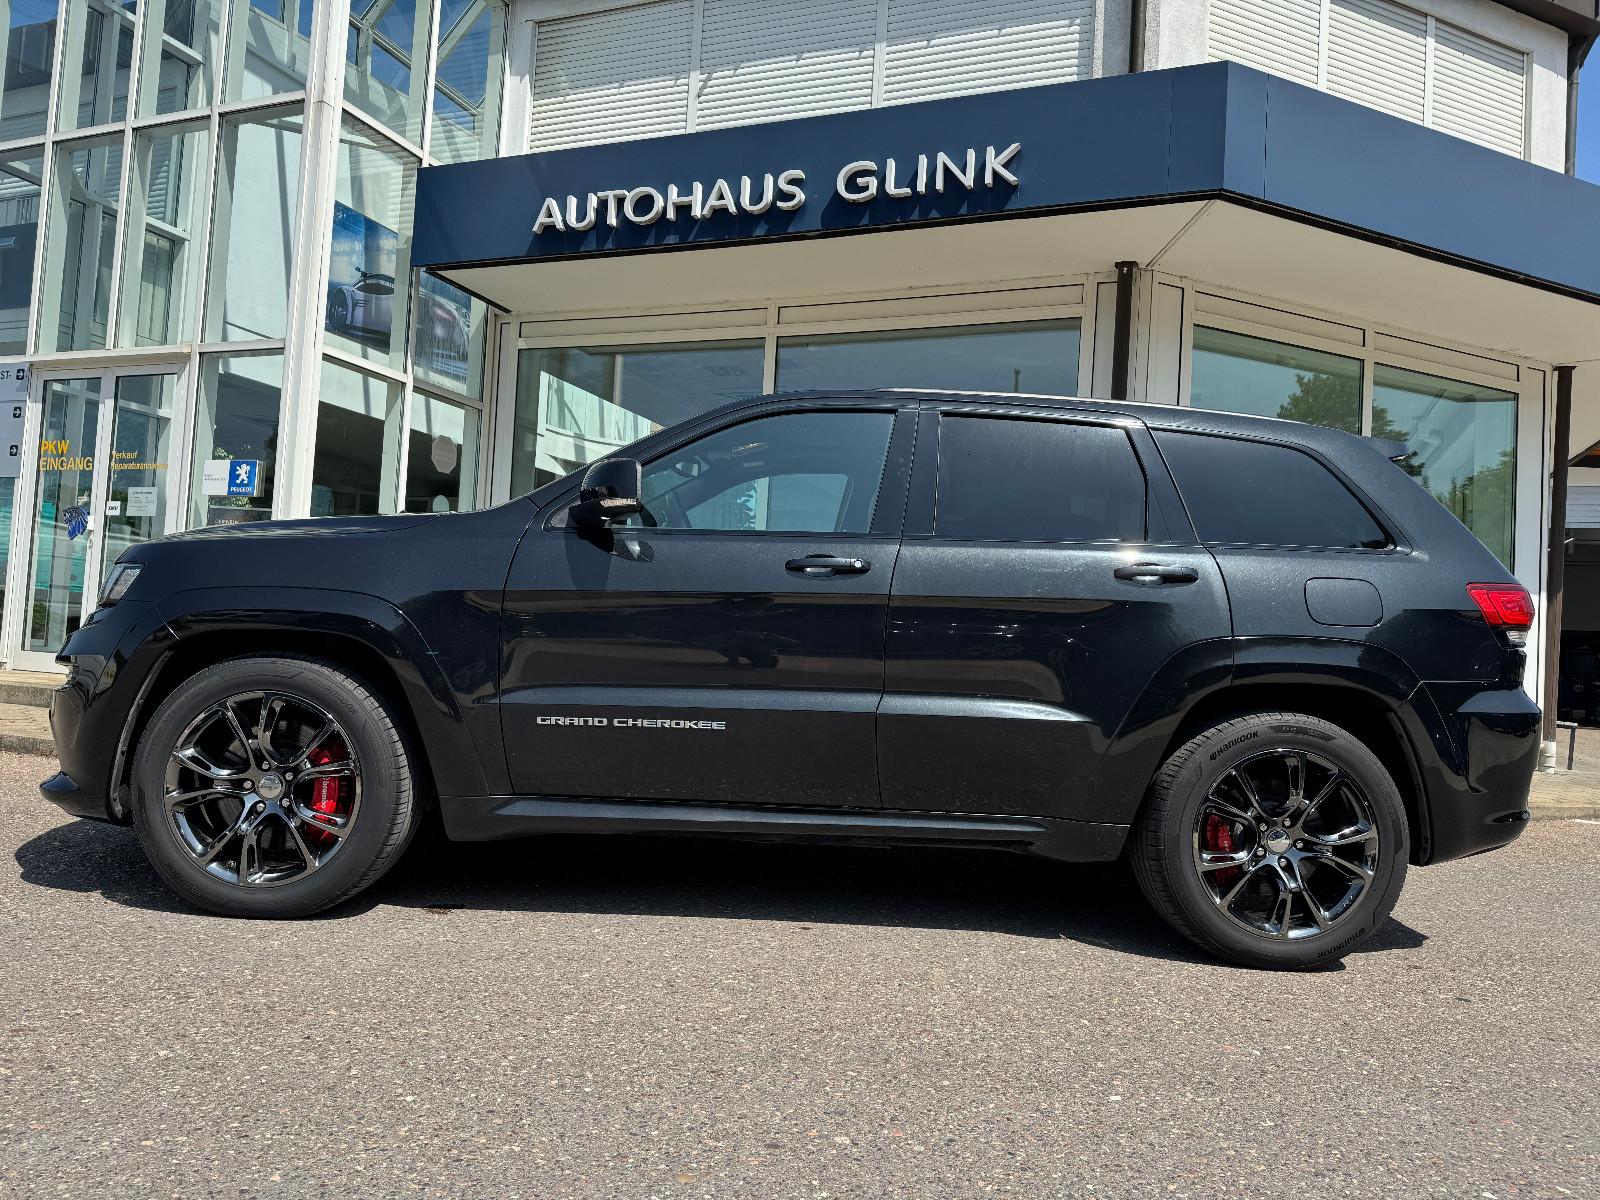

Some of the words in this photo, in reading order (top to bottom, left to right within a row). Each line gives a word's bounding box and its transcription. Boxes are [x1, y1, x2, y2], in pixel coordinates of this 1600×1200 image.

[533, 169, 806, 234] AUTOHAUS
[836, 142, 1022, 202] GLINK
[41, 440, 69, 454] PKW
[39, 457, 93, 471] EINGANG
[536, 716, 608, 726] GRAND
[613, 718, 727, 730] CHEROKEE
[321, 780, 329, 809] brembo
